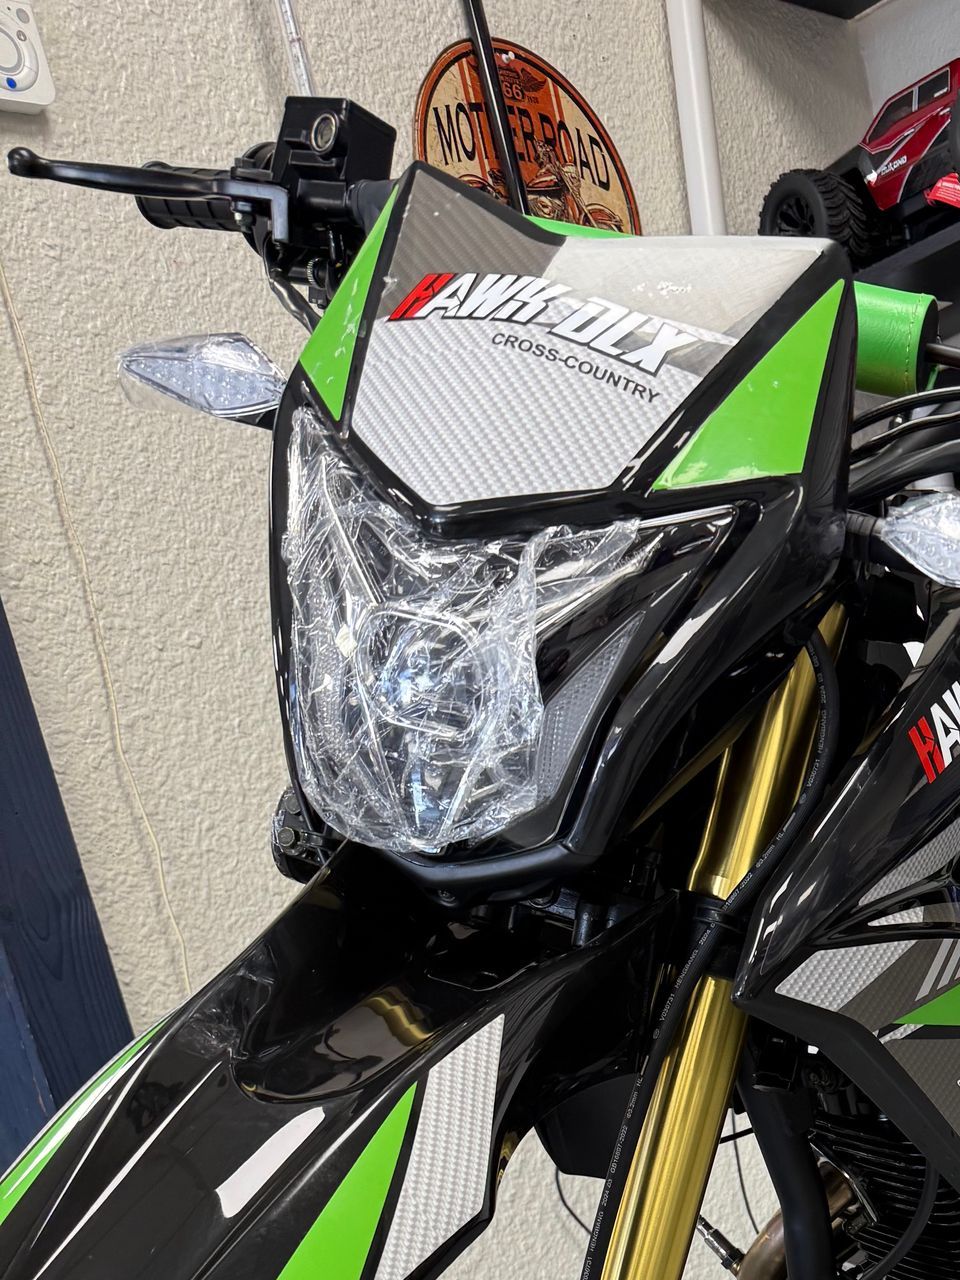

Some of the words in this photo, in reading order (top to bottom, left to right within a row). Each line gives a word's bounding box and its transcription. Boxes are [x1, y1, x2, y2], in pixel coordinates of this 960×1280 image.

[433, 102, 539, 166] MOTER
[538, 111, 611, 191] ROAD
[386, 272, 573, 325] HAWK
[546, 296, 700, 377] DLX
[491, 332, 661, 404] CROSS-COUNTRY
